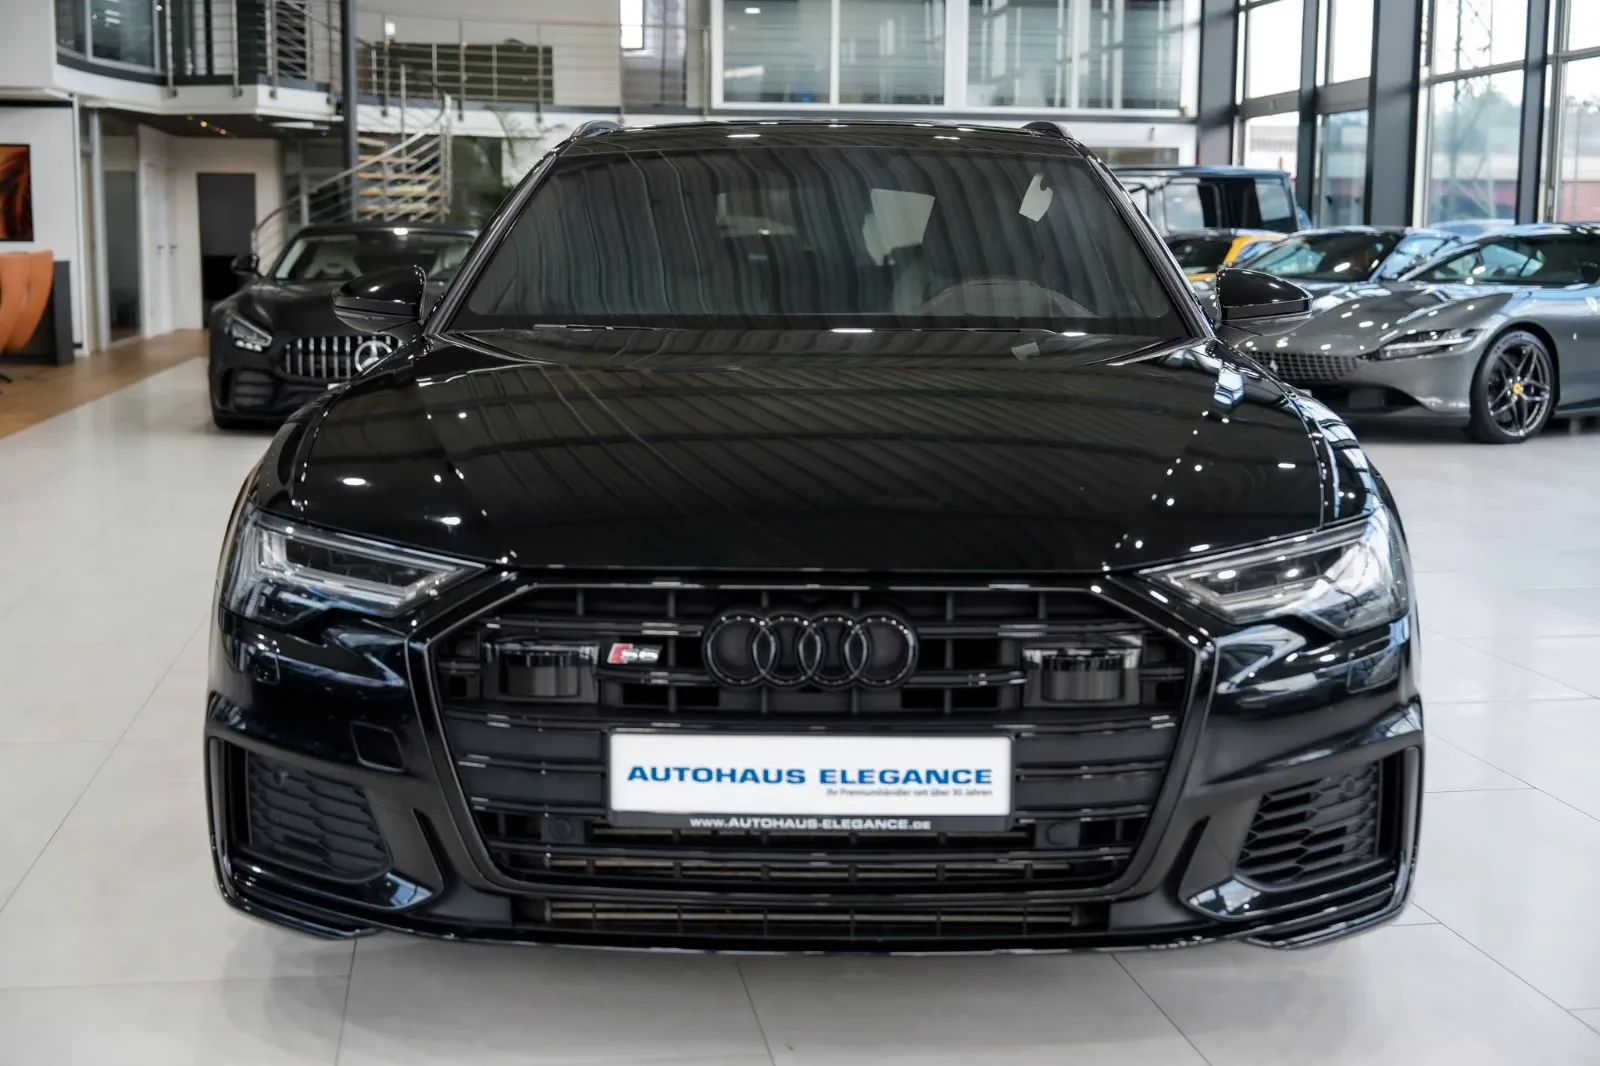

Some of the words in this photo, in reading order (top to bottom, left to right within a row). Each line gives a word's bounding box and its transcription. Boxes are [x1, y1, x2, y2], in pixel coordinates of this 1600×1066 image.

[627, 766, 806, 784] AUTOHAUS
[819, 769, 993, 785] ELEGANCE
[965, 788, 993, 797] Jahren
